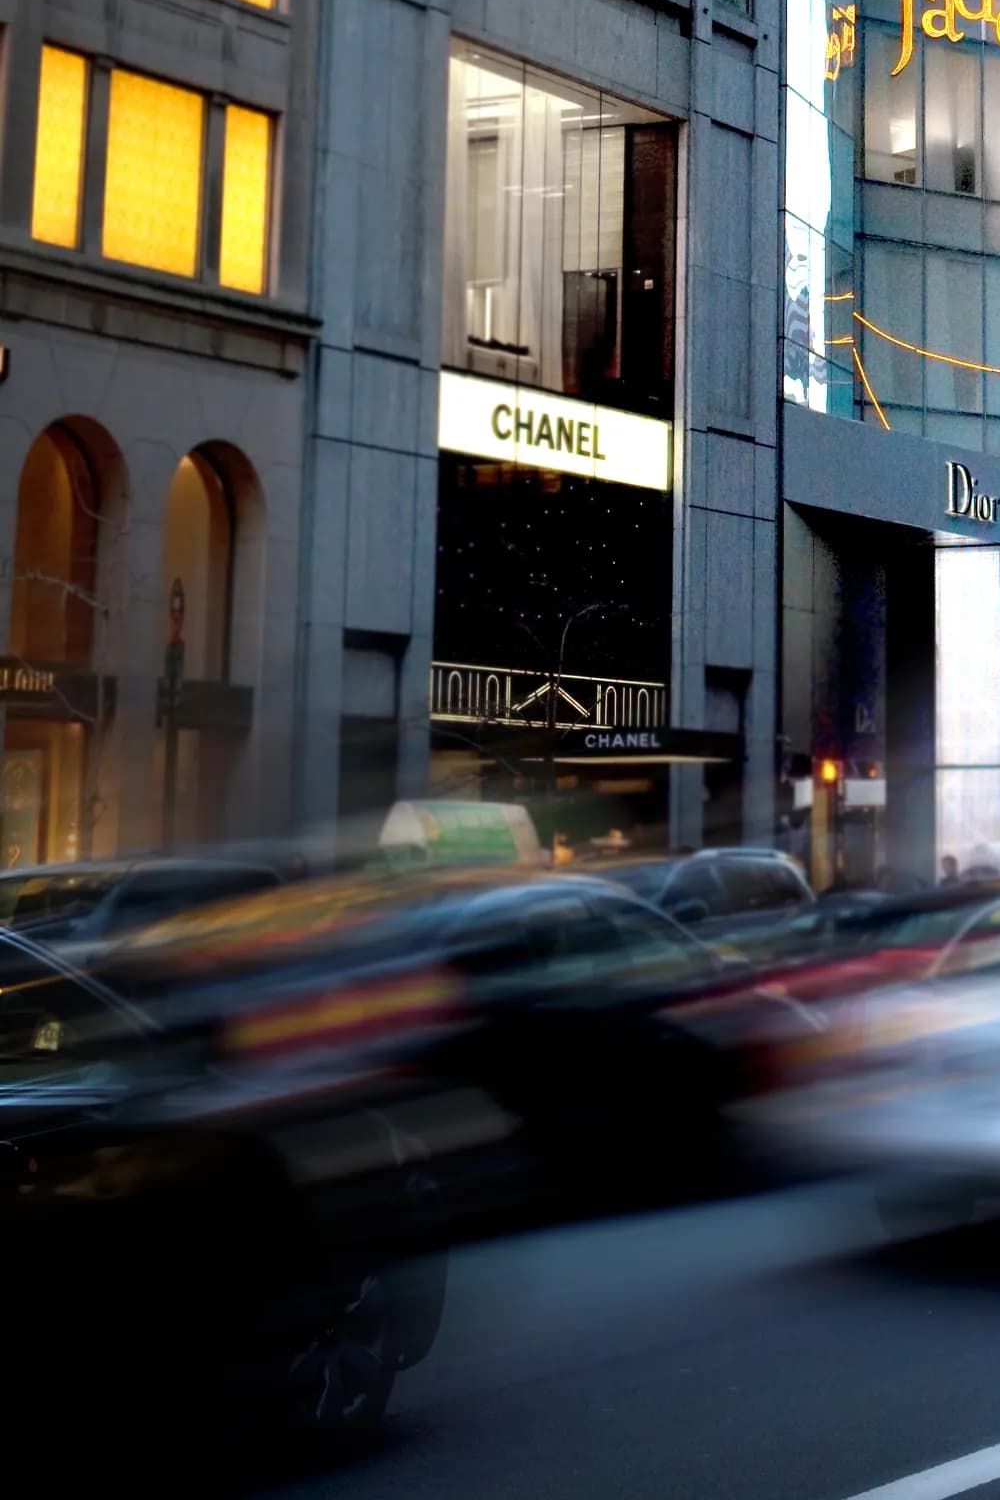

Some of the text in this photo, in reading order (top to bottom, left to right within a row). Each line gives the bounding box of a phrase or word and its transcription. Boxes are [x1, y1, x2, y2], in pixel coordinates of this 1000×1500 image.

[491, 404, 606, 460] CHANEL
[944, 461, 1000, 522] Dior
[584, 733, 661, 748] CHANEL
